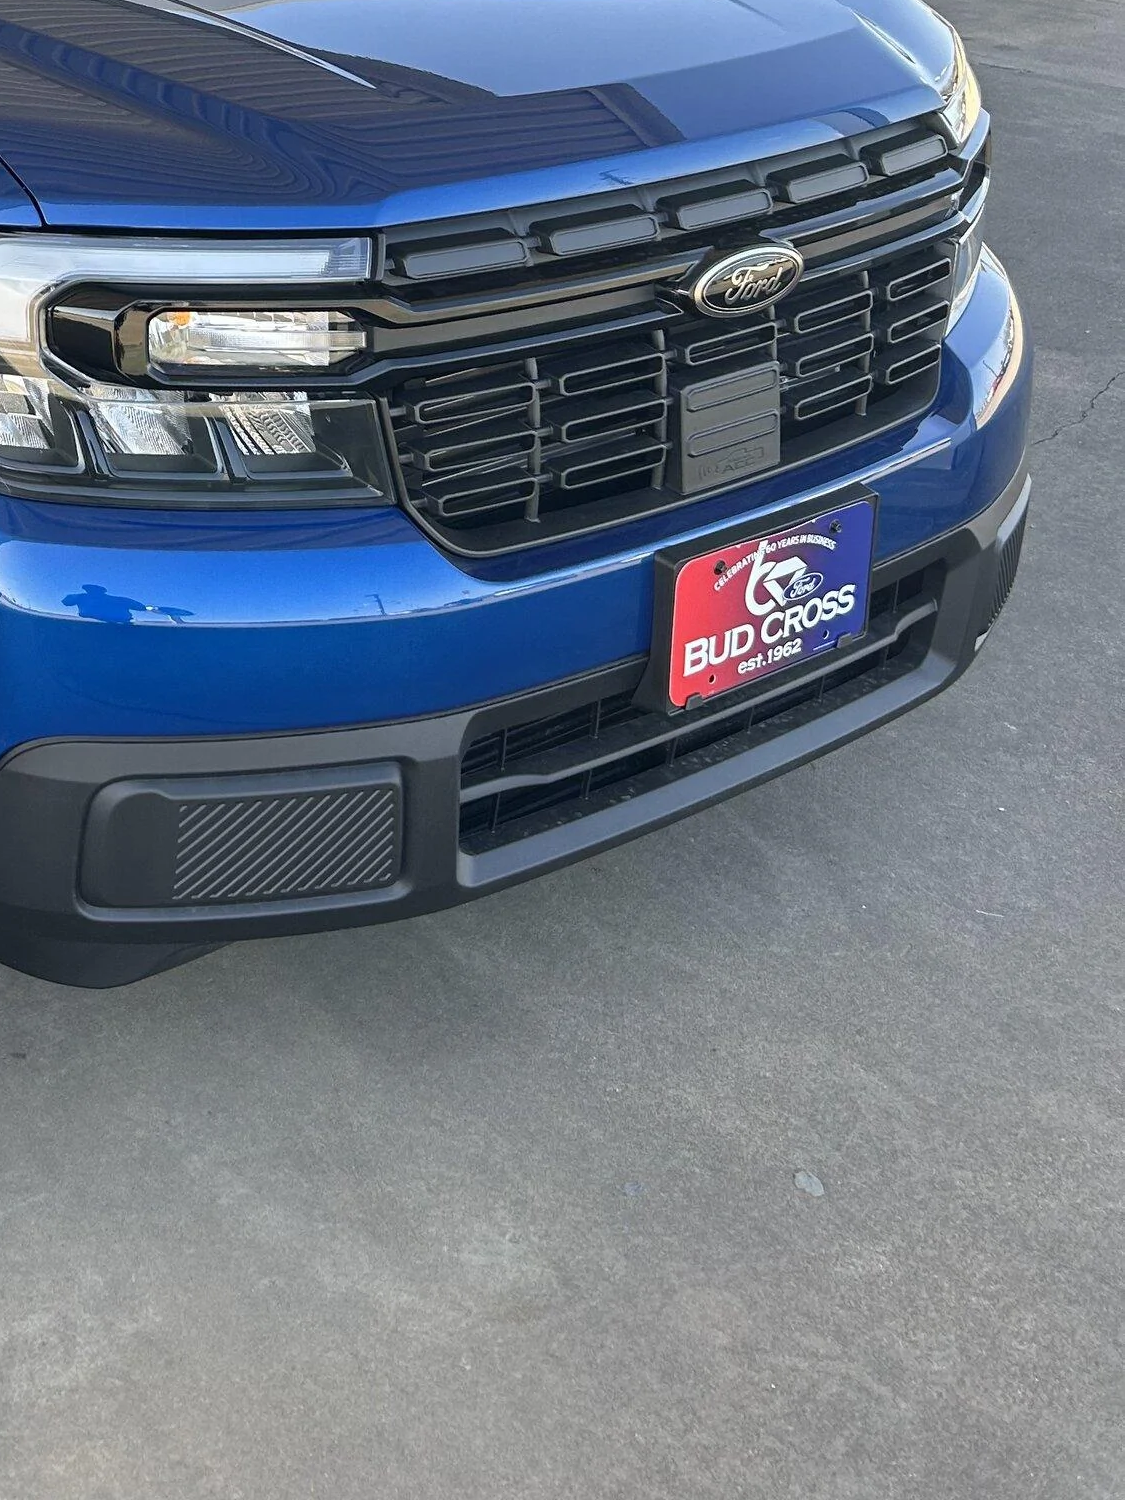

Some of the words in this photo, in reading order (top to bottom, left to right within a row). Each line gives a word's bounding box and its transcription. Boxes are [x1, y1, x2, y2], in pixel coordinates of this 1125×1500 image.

[724, 262, 784, 306] Ford
[766, 542, 777, 554] 60
[777, 535, 800, 549] YEARS
[807, 533, 837, 551] BUSINESS
[789, 576, 816, 598] Ford
[683, 626, 755, 677] BUD
[760, 584, 857, 645] CROSS
